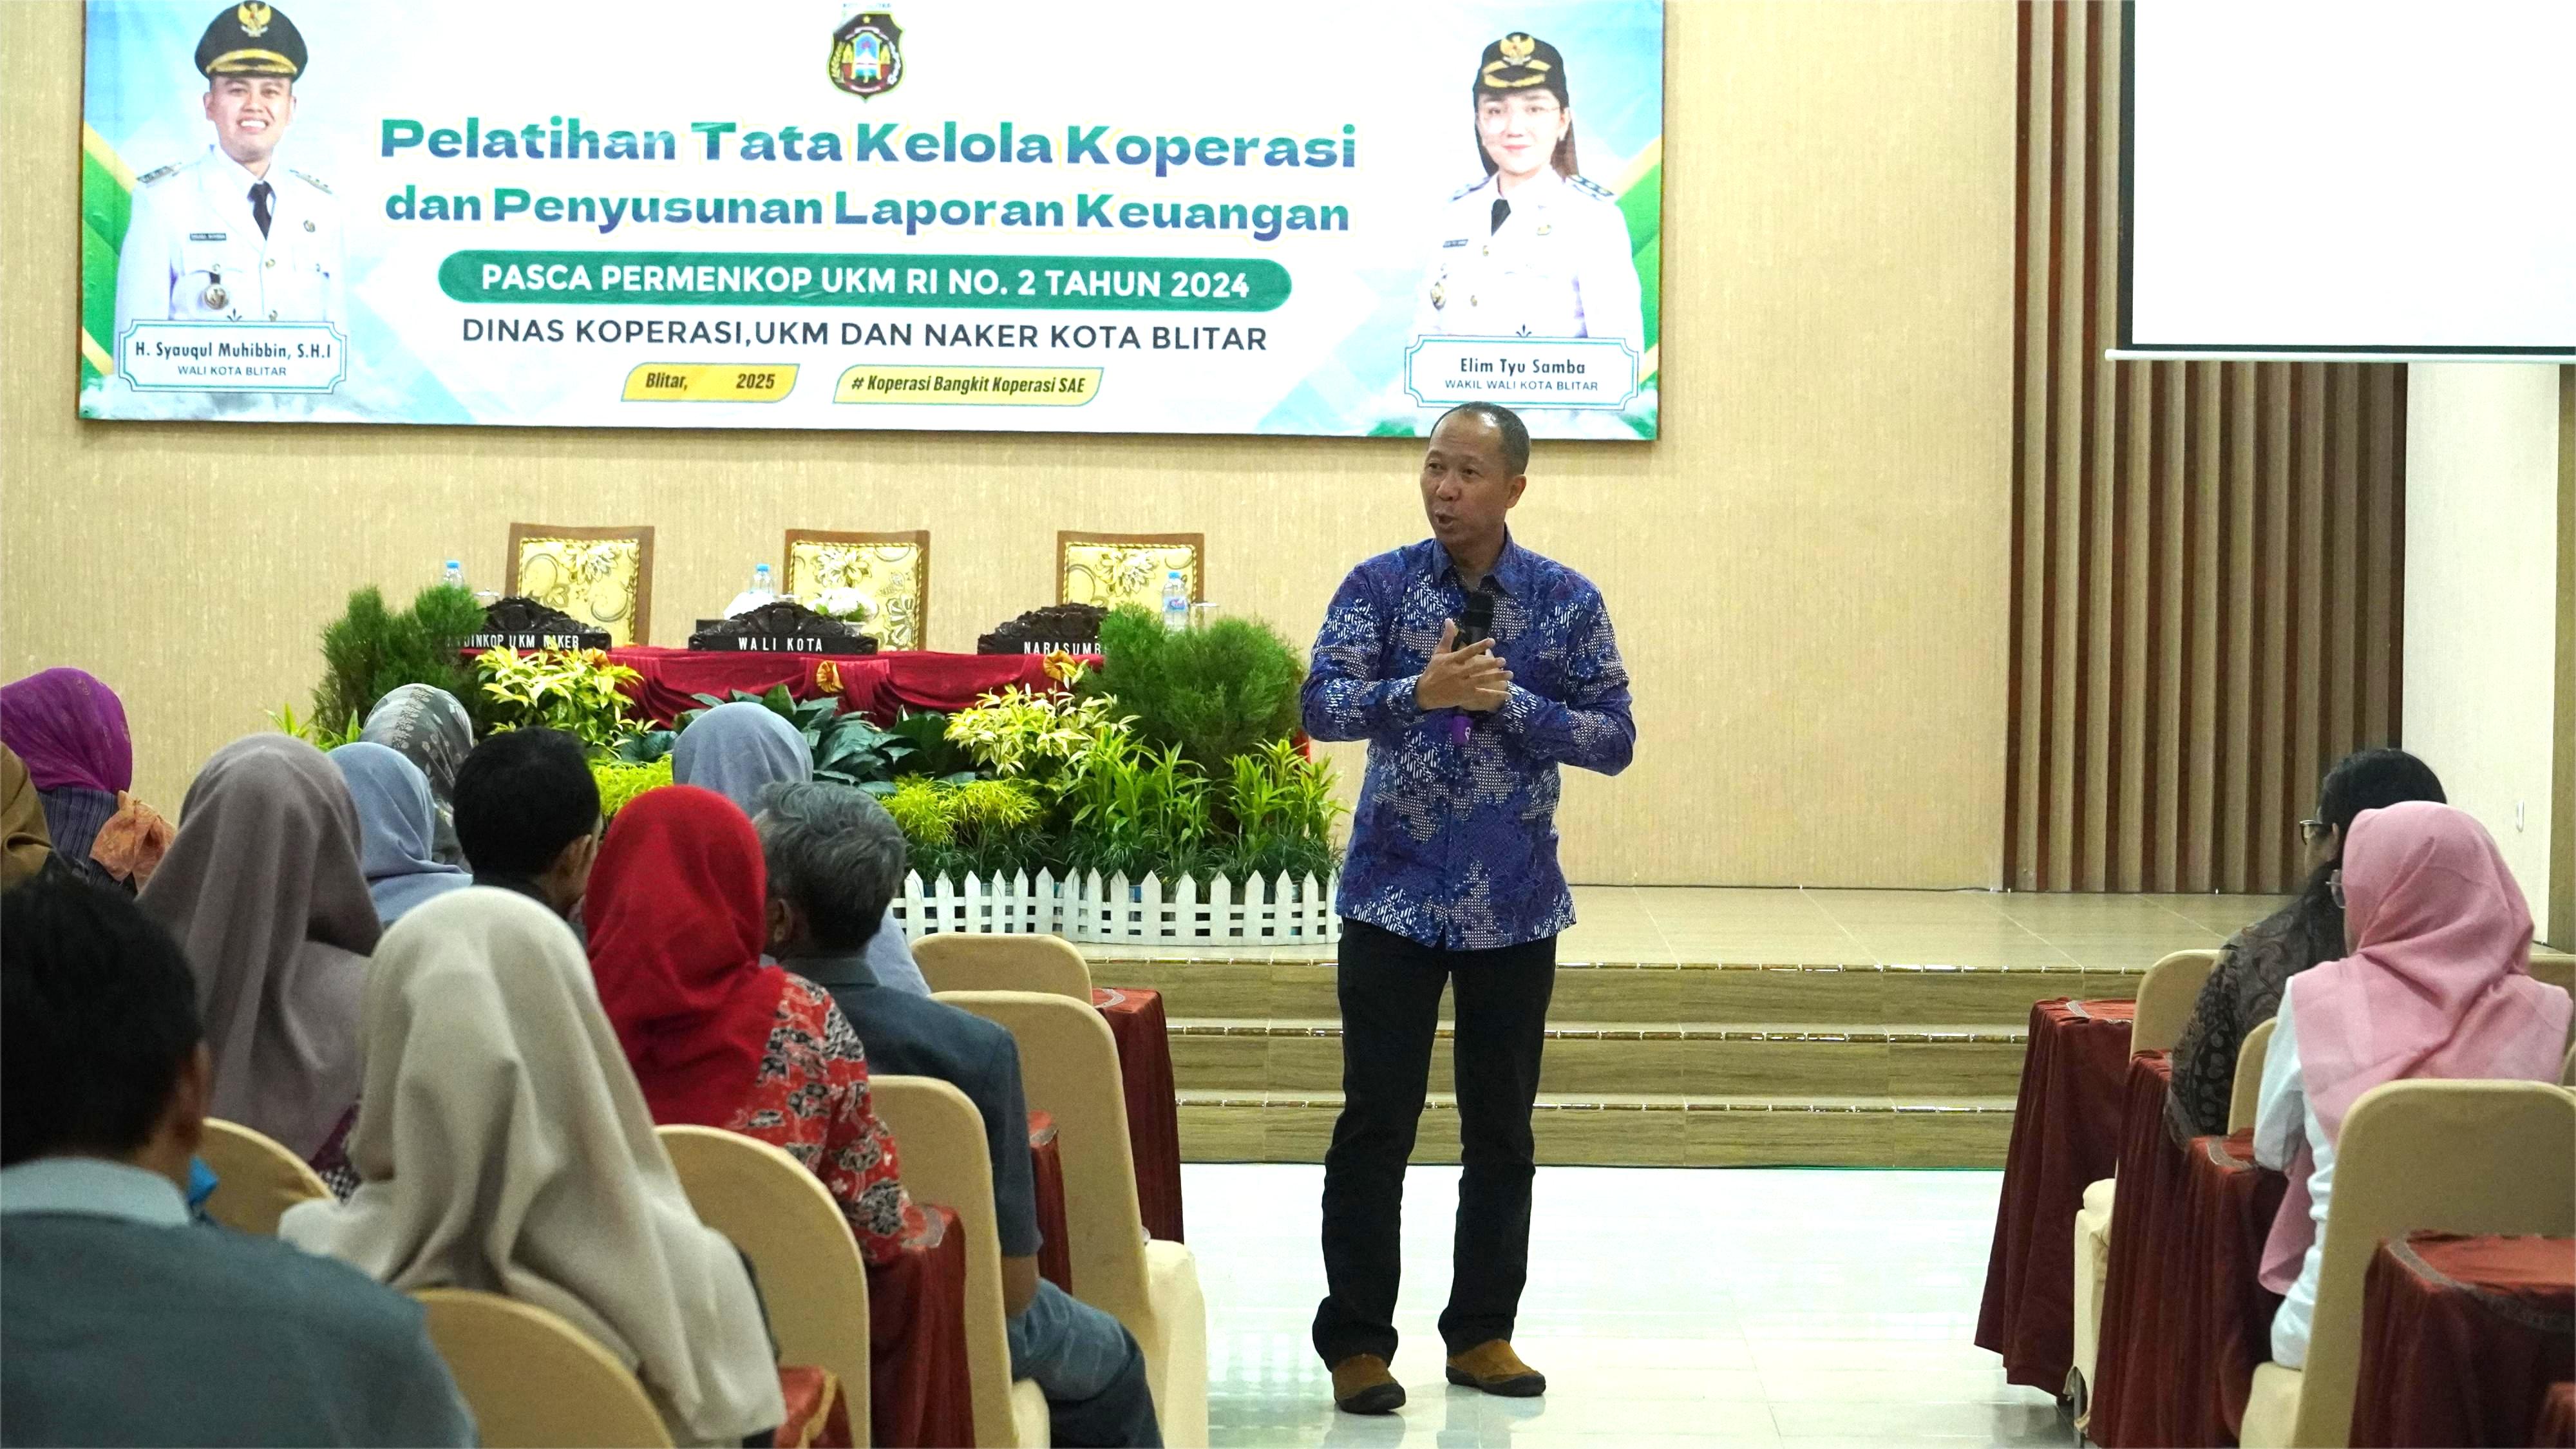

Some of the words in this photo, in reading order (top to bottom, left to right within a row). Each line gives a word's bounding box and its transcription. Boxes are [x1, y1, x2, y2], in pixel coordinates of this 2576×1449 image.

[381, 115, 676, 160] Pelatihan
[691, 122, 842, 162] Tata
[857, 121, 1053, 164] Kelola
[1067, 124, 1355, 178] Koperasi
[386, 185, 481, 221] dan
[494, 188, 822, 234] Penyusunan
[835, 191, 1063, 236] Laporan
[1077, 194, 1349, 242] Keuangan
[482, 263, 592, 290] PASCA
[601, 265, 812, 292] PERMENKOP
[821, 267, 896, 294] UKM
[907, 268, 938, 294] RI
[949, 269, 1008, 295] NO.
[1018, 269, 1036, 296] 2
[1045, 270, 1160, 297] TAHUN
[1171, 270, 1250, 298] 2024
[463, 319, 564, 342] DINAS
[842, 323, 911, 346] DAN
[925, 323, 1037, 348] NAKER
[1051, 325, 1141, 349] KOTA
[1153, 327, 1266, 350] BLITAR
[156, 341, 212, 361] Syauqul
[218, 342, 291, 359] Muhibbin,
[298, 343, 330, 358] S.H.I
[178, 365, 207, 375] WALI
[211, 366, 242, 375] KOTA
[245, 366, 287, 376] BLITAR
[1461, 357, 1493, 372] Elim
[1500, 358, 1526, 377] Tyu
[1533, 359, 1585, 374] Samba
[645, 372, 688, 391] Blitar,
[736, 374, 775, 389] 2025
[867, 375, 931, 394] Koperasi
[933, 375, 990, 395] Bangkit
[992, 377, 1056, 395] Koperasi
[1058, 377, 1086, 393] SAE
[1445, 379, 1482, 389] WAKIL
[1486, 380, 1515, 390] WALI
[1520, 381, 1553, 390] KOTA
[1557, 381, 1598, 391] BLITAR
[509, 634, 535, 648] UKM
[738, 637, 777, 651] WALI
[786, 638, 823, 652] KOTA
[1023, 641, 1105, 656] NARASUMB
